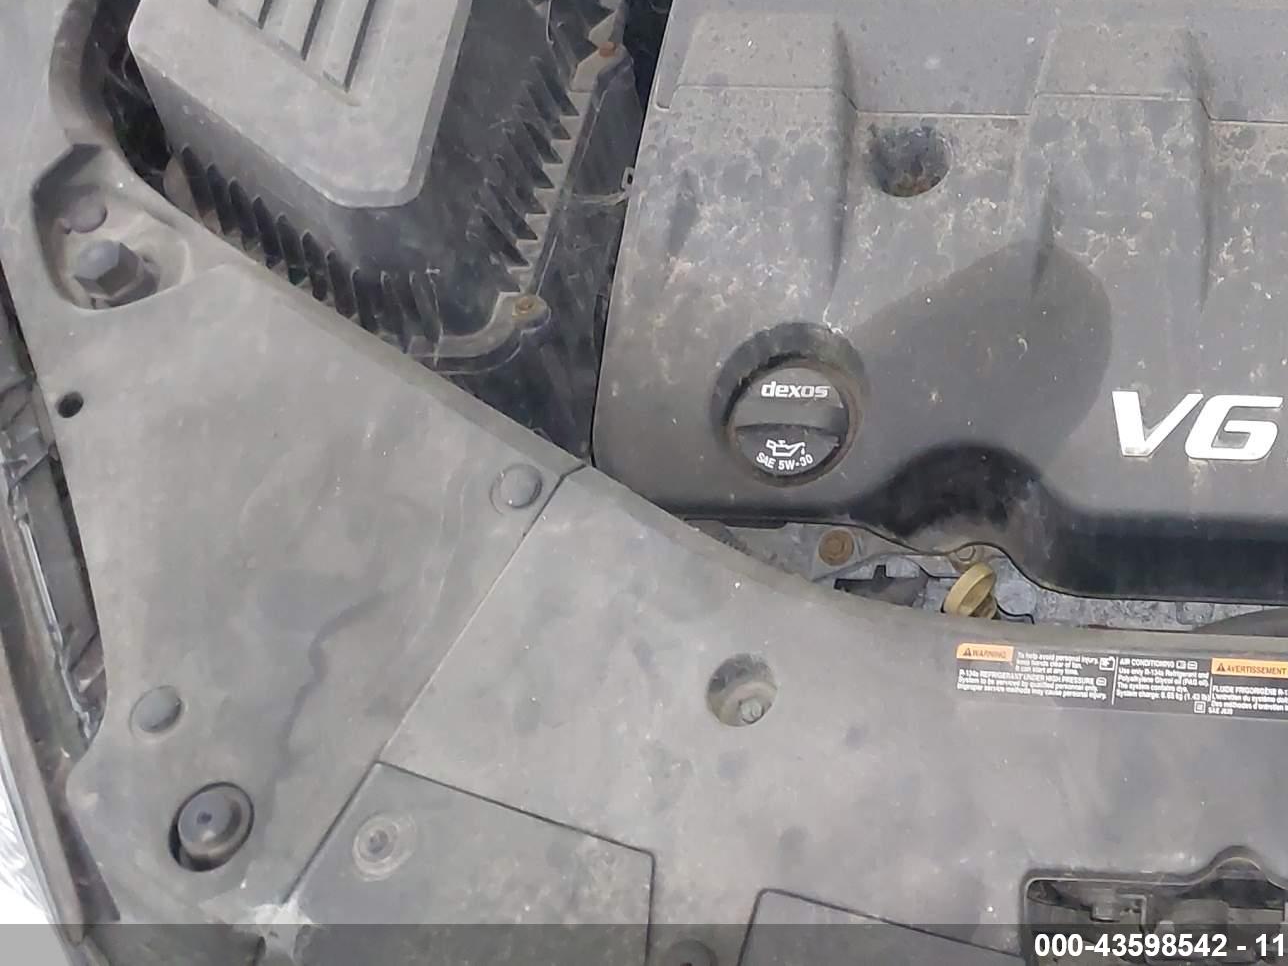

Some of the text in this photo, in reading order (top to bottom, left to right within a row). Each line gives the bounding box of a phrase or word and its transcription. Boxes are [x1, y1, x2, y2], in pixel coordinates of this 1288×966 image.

[761, 381, 831, 398] dexos
[1112, 391, 1284, 461] V6
[756, 452, 813, 470] SAE 5W-30
[973, 650, 1006, 659] WARNING
[1227, 666, 1287, 675] AVERTISSEMENT
